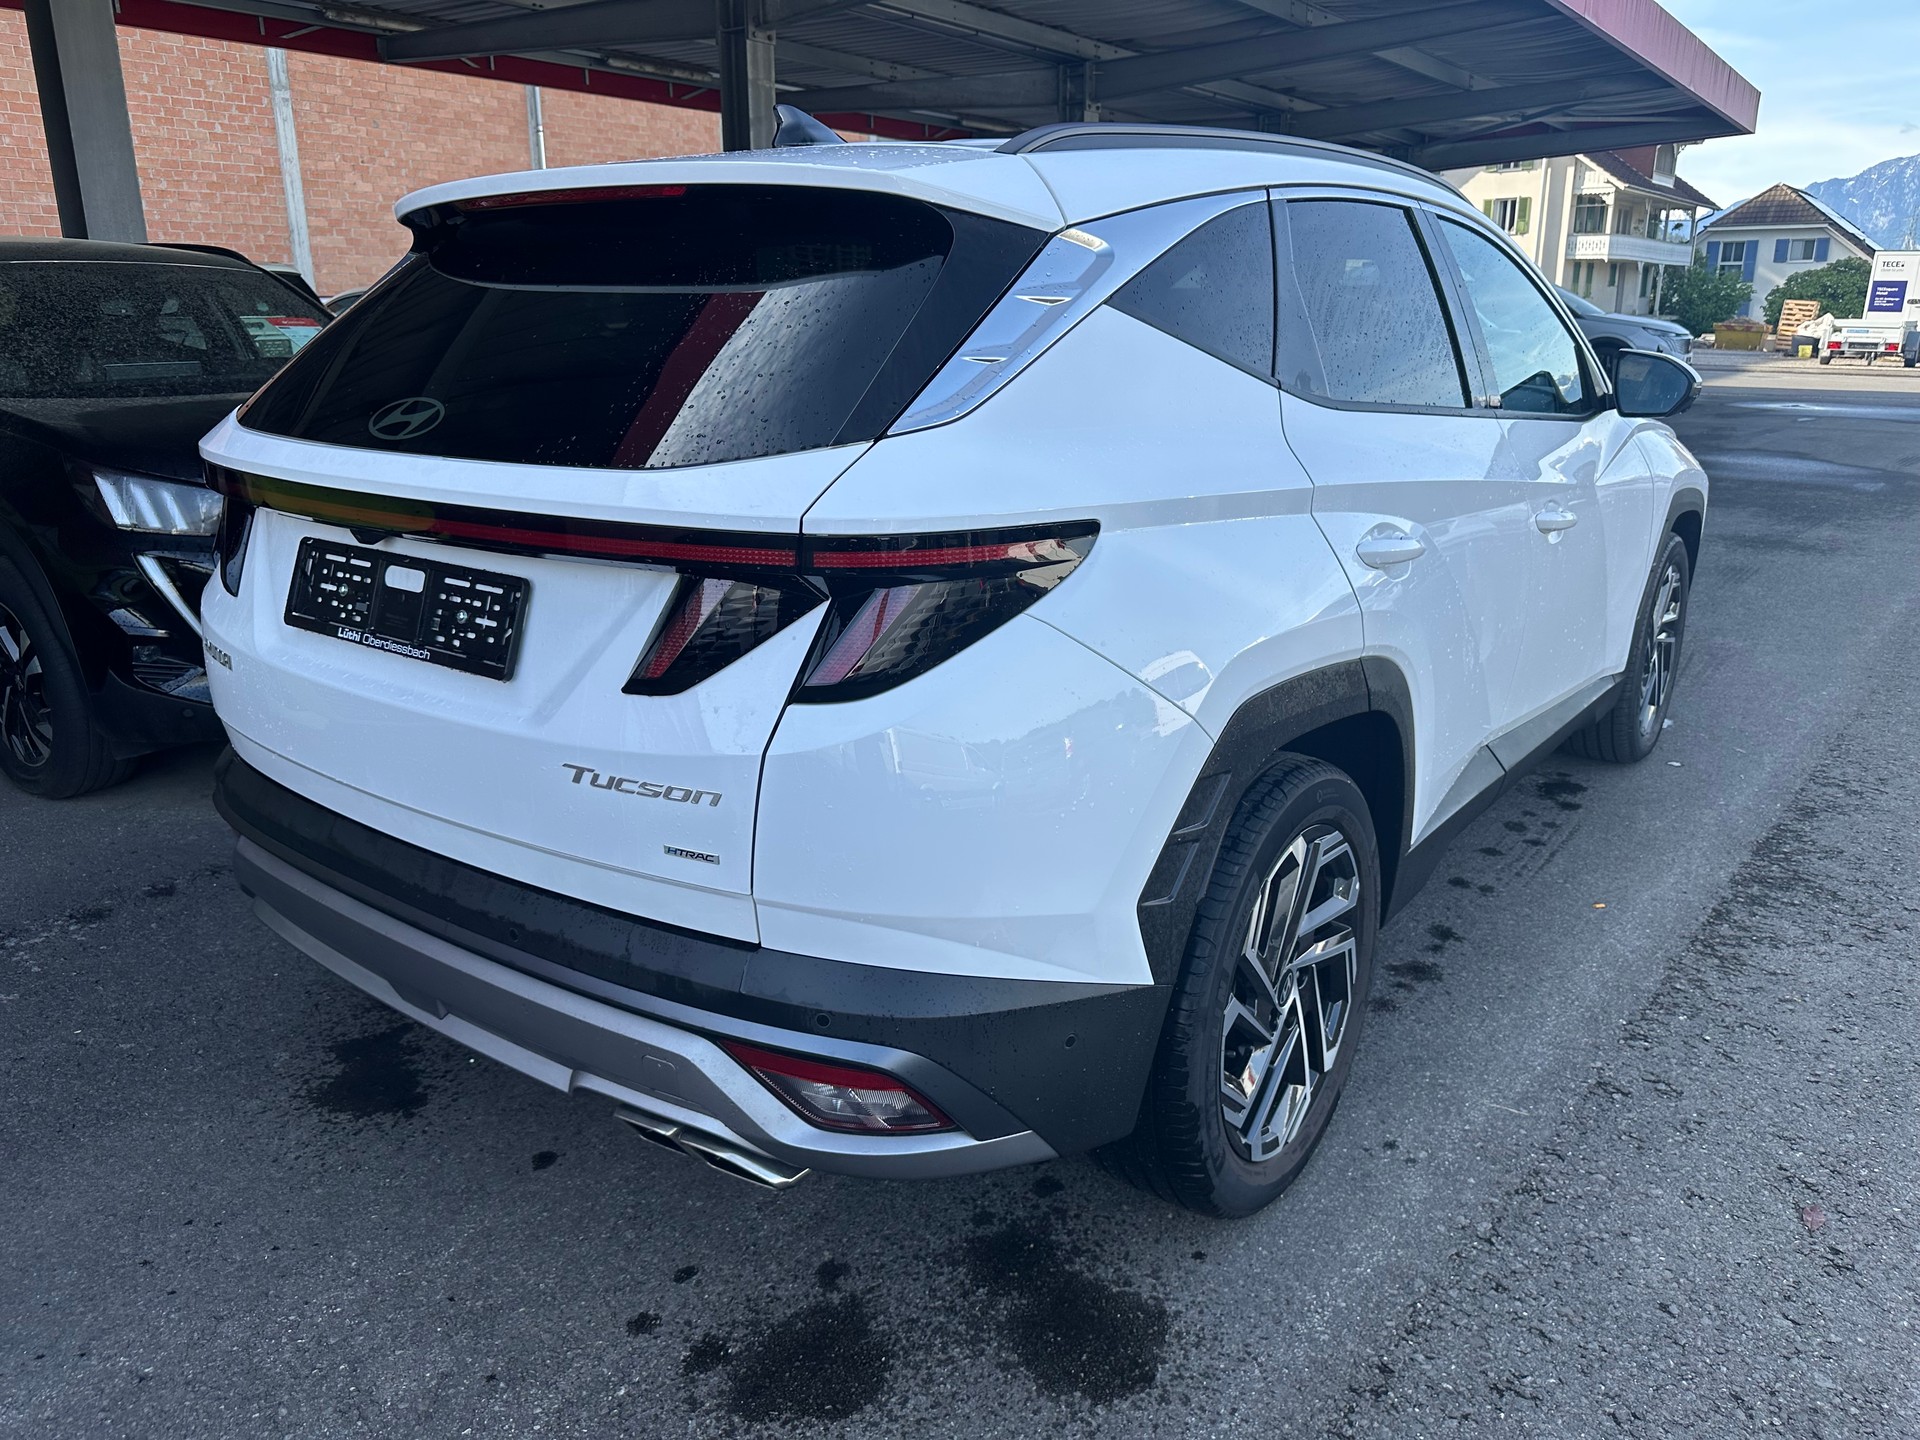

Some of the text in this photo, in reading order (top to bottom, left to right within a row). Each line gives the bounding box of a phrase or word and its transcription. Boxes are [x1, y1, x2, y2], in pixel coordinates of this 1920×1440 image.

[338, 627, 431, 660] Lüthi Oberdiessbach
[667, 847, 715, 863] HTRAC
